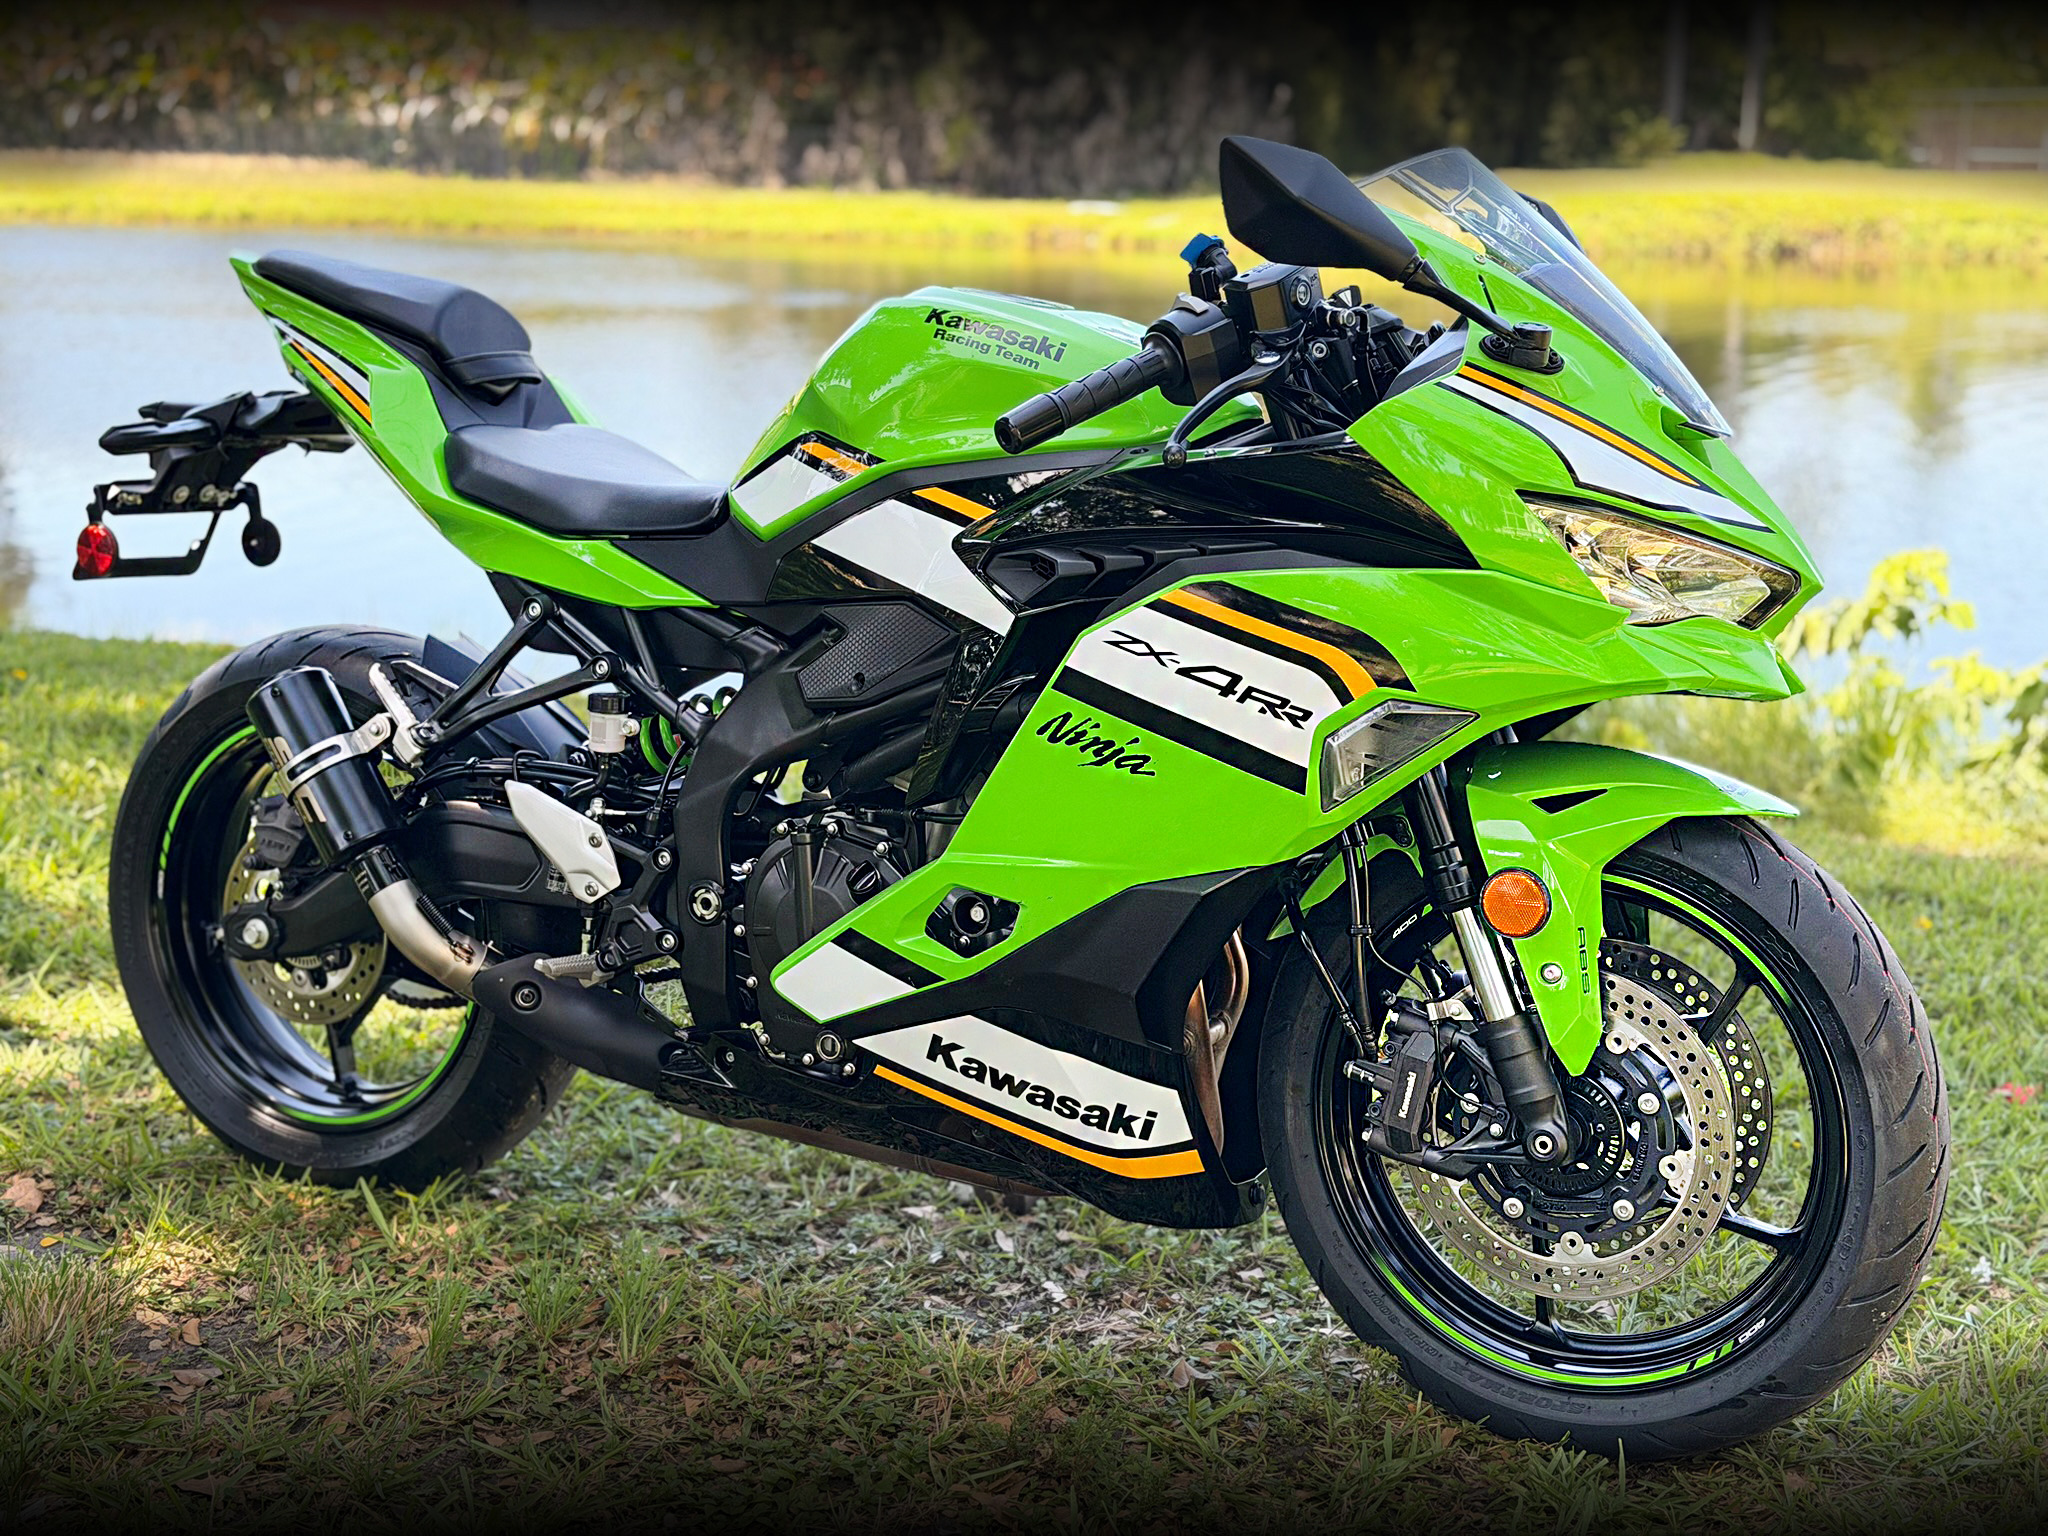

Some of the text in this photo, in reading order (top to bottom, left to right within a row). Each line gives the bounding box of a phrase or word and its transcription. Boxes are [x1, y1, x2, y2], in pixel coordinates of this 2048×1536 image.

[924, 307, 1067, 363] Kawasaki
[933, 327, 1040, 370] Racing Team
[1102, 630, 1314, 730] ZX-4RR
[1036, 711, 1156, 776] Ninja
[1577, 926, 1591, 994] ABS
[926, 1033, 1159, 1141] Kawasaki
[1397, 1070, 1417, 1119] Kawasaki
